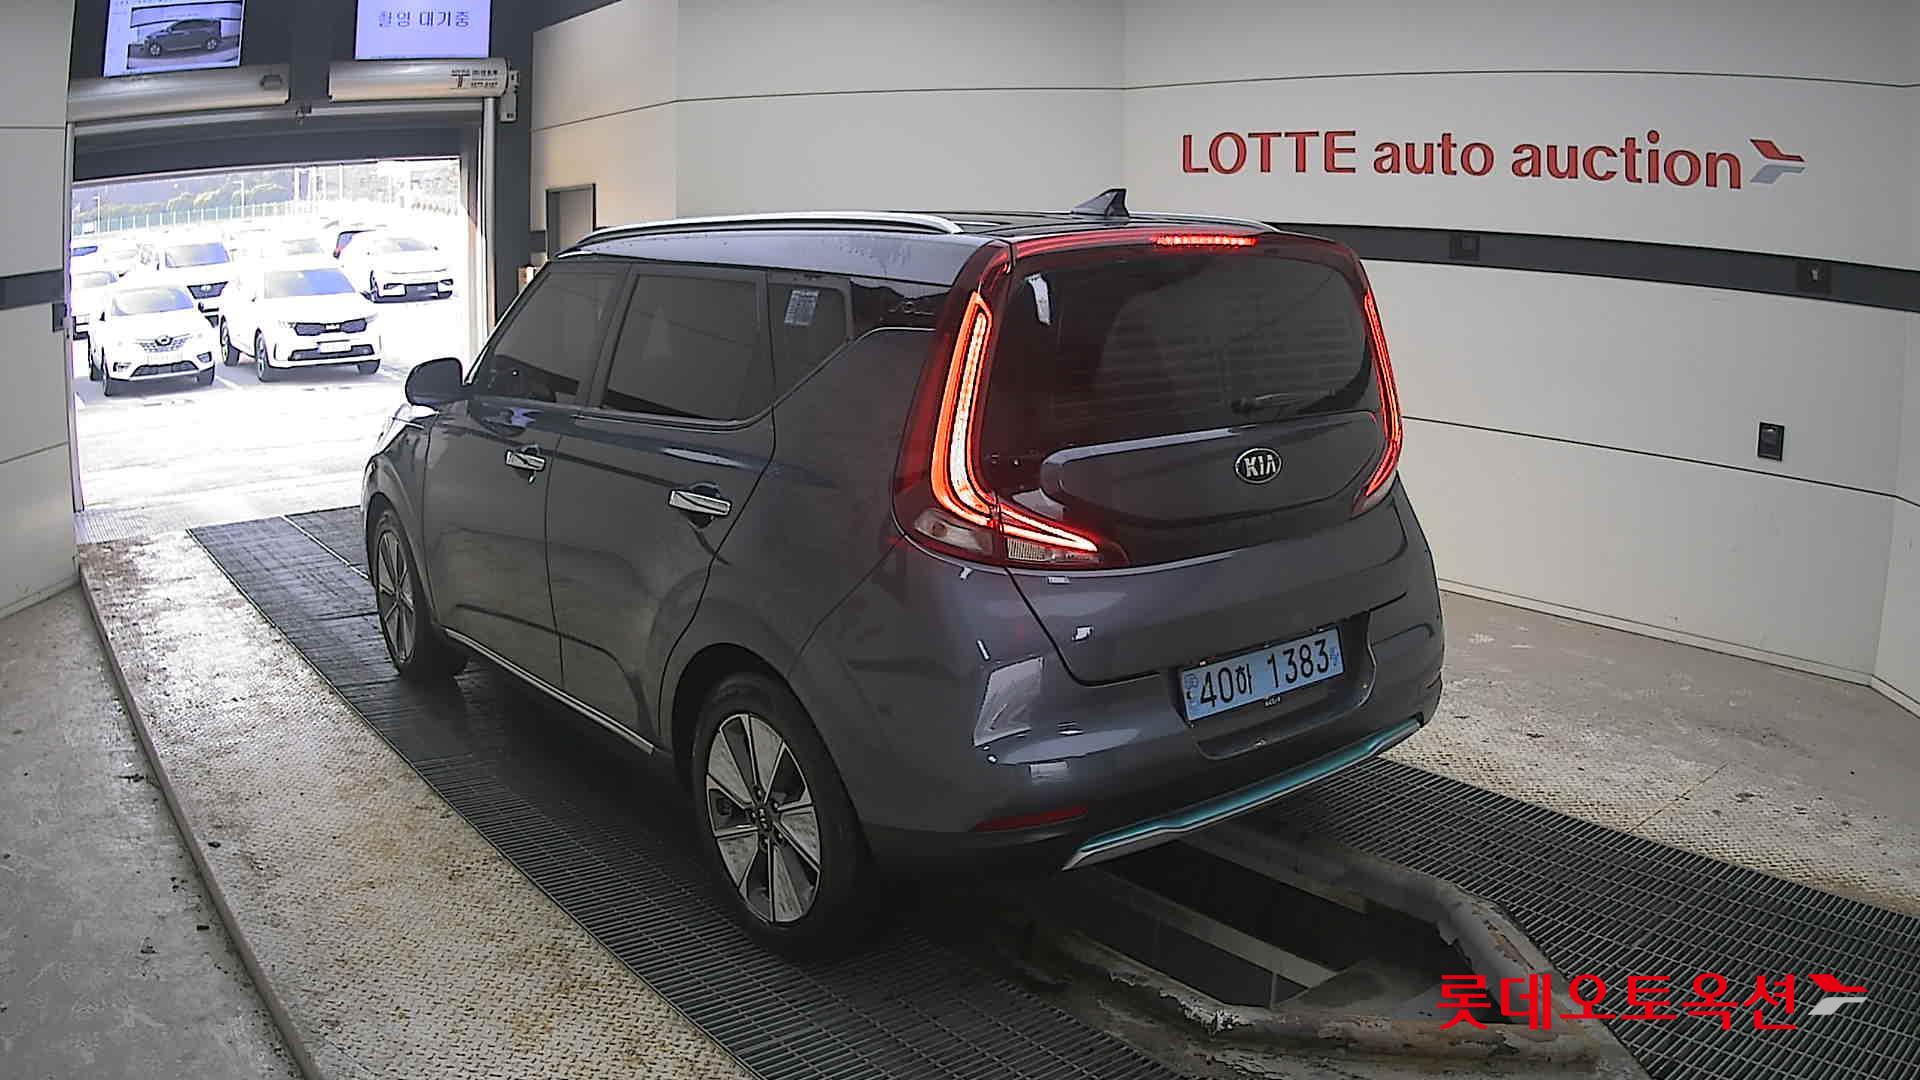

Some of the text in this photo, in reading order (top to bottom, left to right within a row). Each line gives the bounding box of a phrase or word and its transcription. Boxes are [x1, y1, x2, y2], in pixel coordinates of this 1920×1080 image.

[419, 11, 470, 27] 대기중
[1182, 129, 1742, 190] LOTTE auto auction
[1243, 454, 1276, 477] KIA
[1200, 663, 1253, 707] 40하
[1267, 638, 1330, 689] 1383
